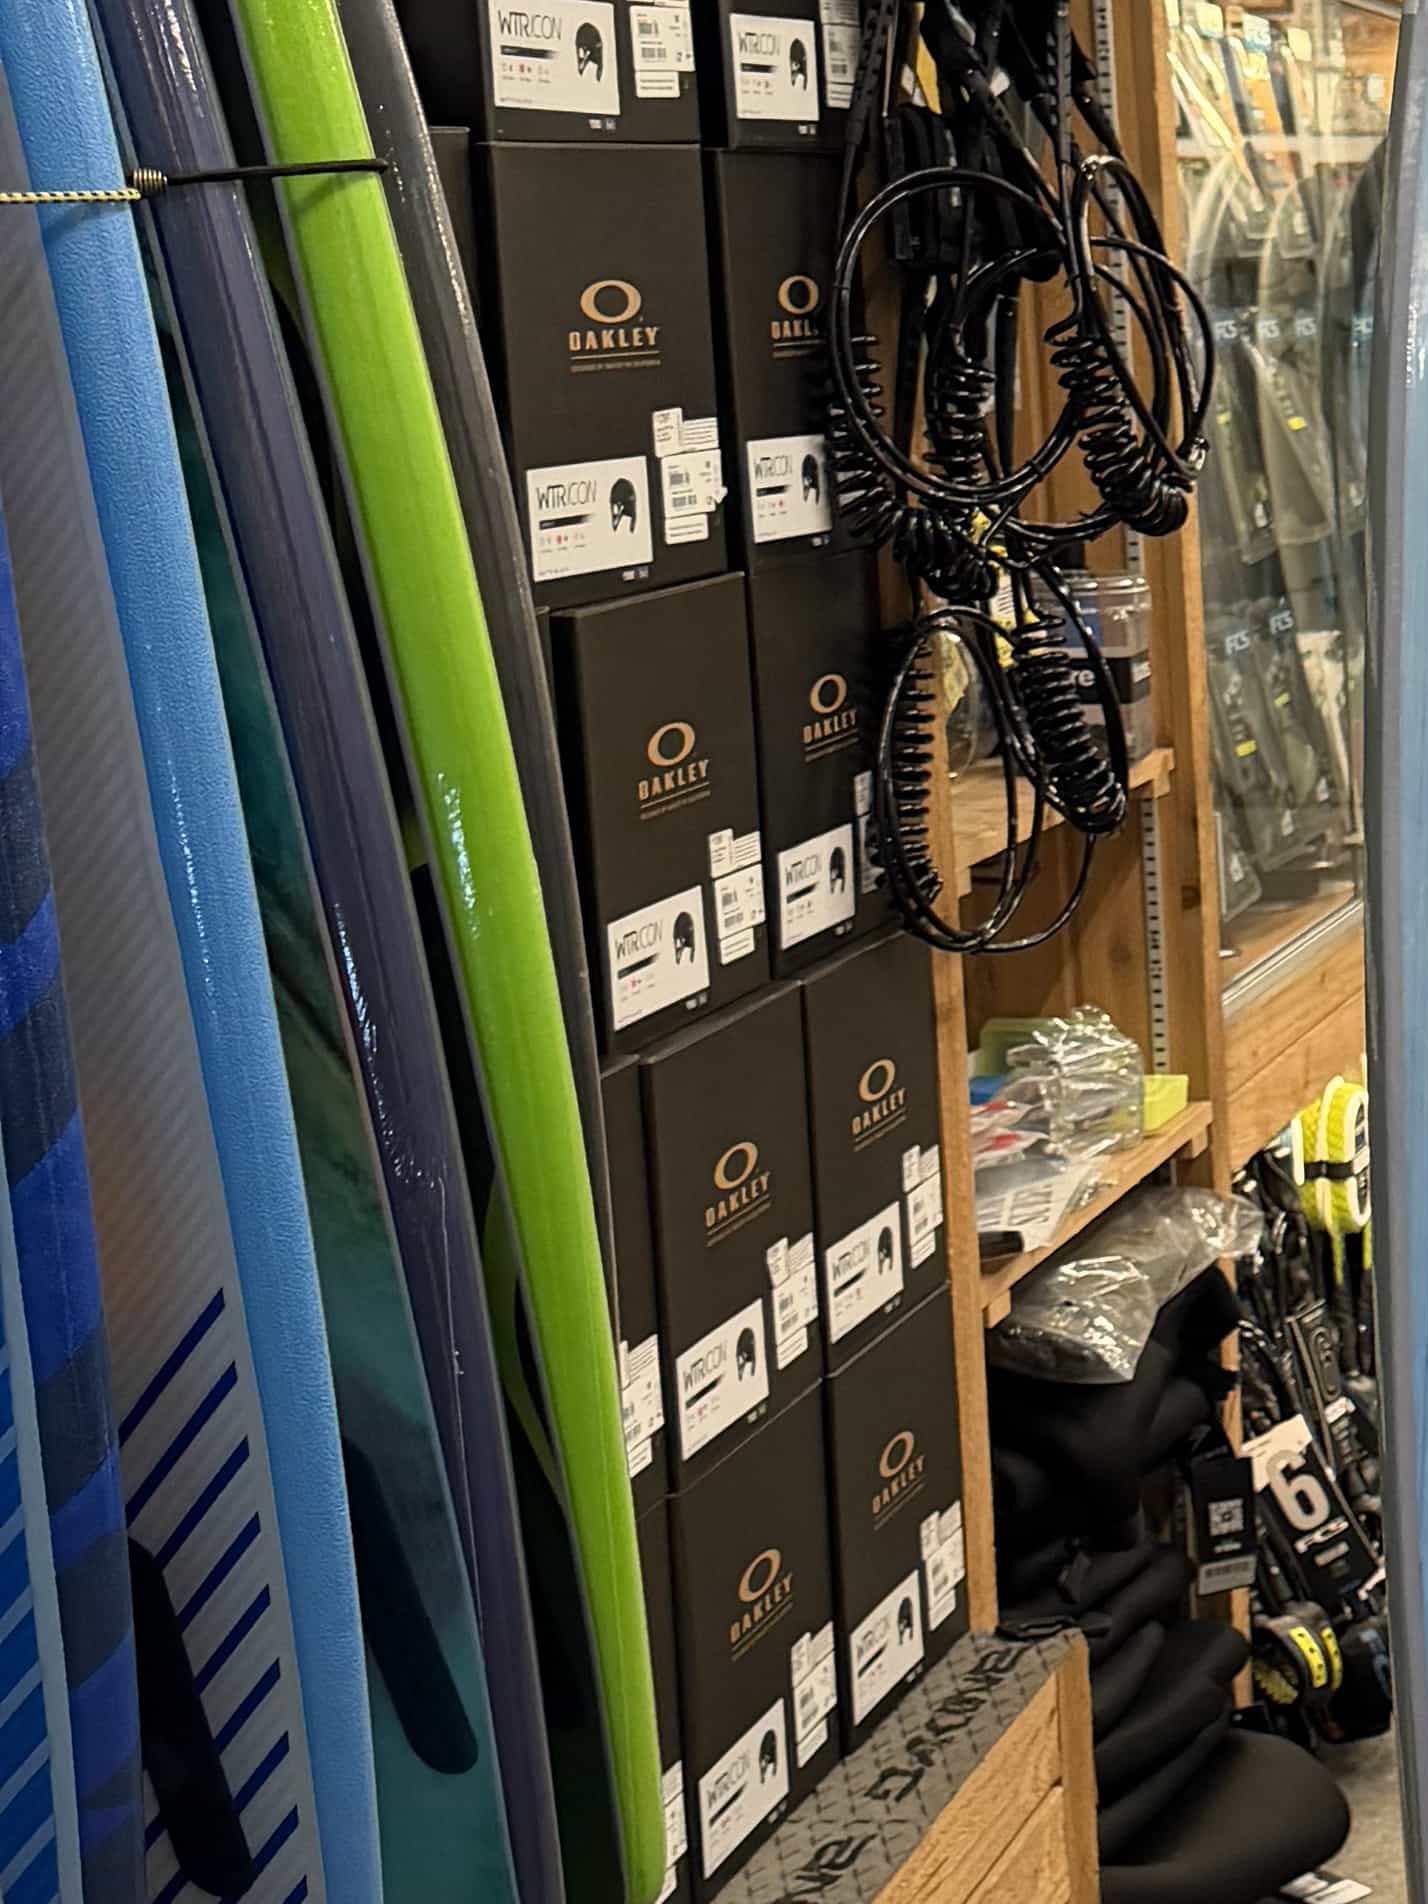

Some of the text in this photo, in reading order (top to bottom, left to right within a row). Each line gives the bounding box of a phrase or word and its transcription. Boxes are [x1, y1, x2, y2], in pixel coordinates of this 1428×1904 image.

[568, 326, 658, 353] OAKLEY
[770, 321, 820, 341] OAKL
[803, 709, 858, 744] OAKLEY
[638, 758, 711, 800] OAKLEY
[852, 1087, 907, 1136] OAKLEY
[704, 1170, 771, 1227] OAKLEY
[871, 1454, 926, 1516] OAKLEY
[1266, 1449, 1331, 1532] 6
[729, 1573, 793, 1645] OAKLEY
[864, 1644, 1025, 1803] DAKINE
